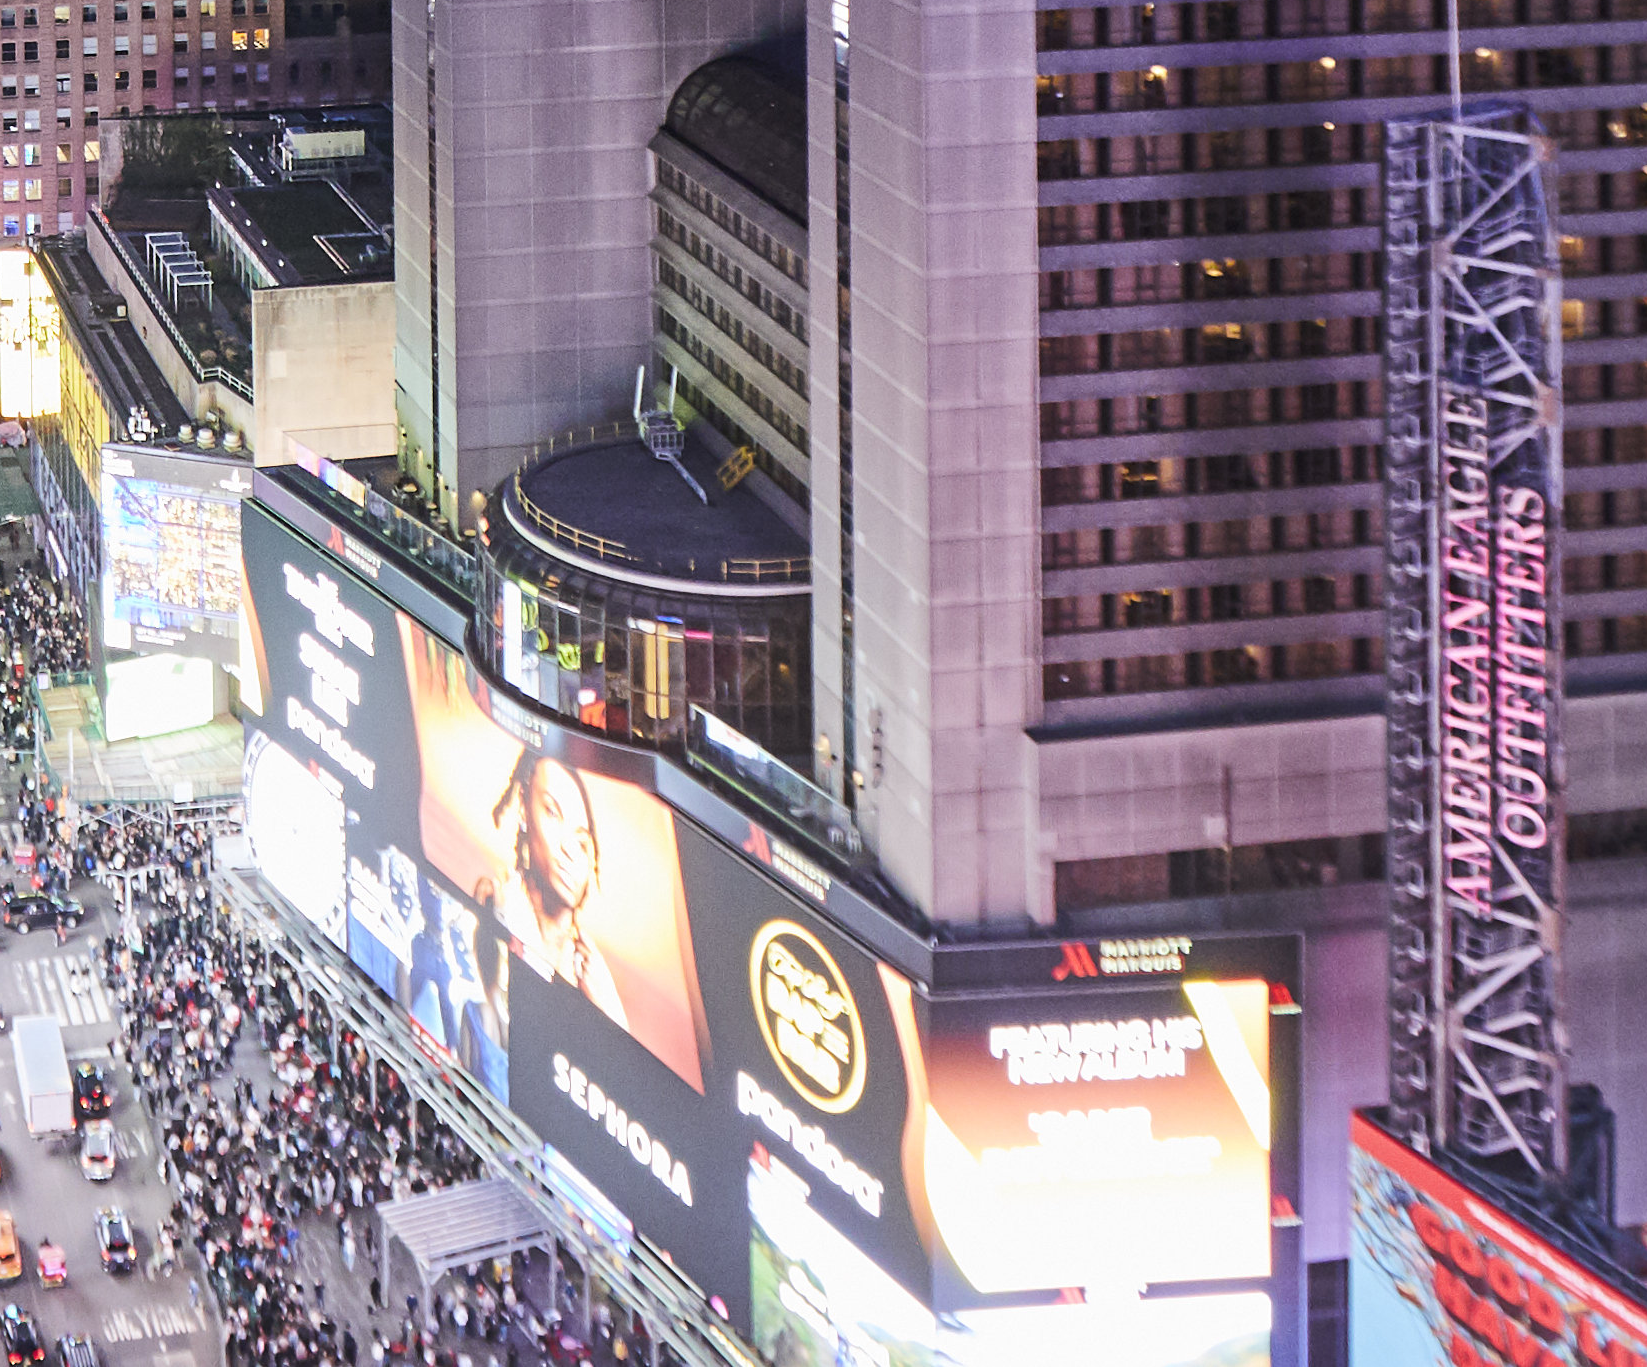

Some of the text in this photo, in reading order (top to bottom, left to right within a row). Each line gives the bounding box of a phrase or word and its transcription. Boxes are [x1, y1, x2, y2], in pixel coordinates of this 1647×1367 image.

[1443, 392, 1492, 913] AMERICAN EAGLE
[1495, 484, 1547, 849] OUTFITTERS
[771, 840, 832, 891] MARRIOTT
[771, 855, 826, 902] MARQUIS
[1099, 937, 1193, 957] MARRIOTT
[1099, 953, 1182, 974] MARQUIS
[553, 1053, 693, 1207] SEPHORA
[737, 1069, 885, 1218] pandora
